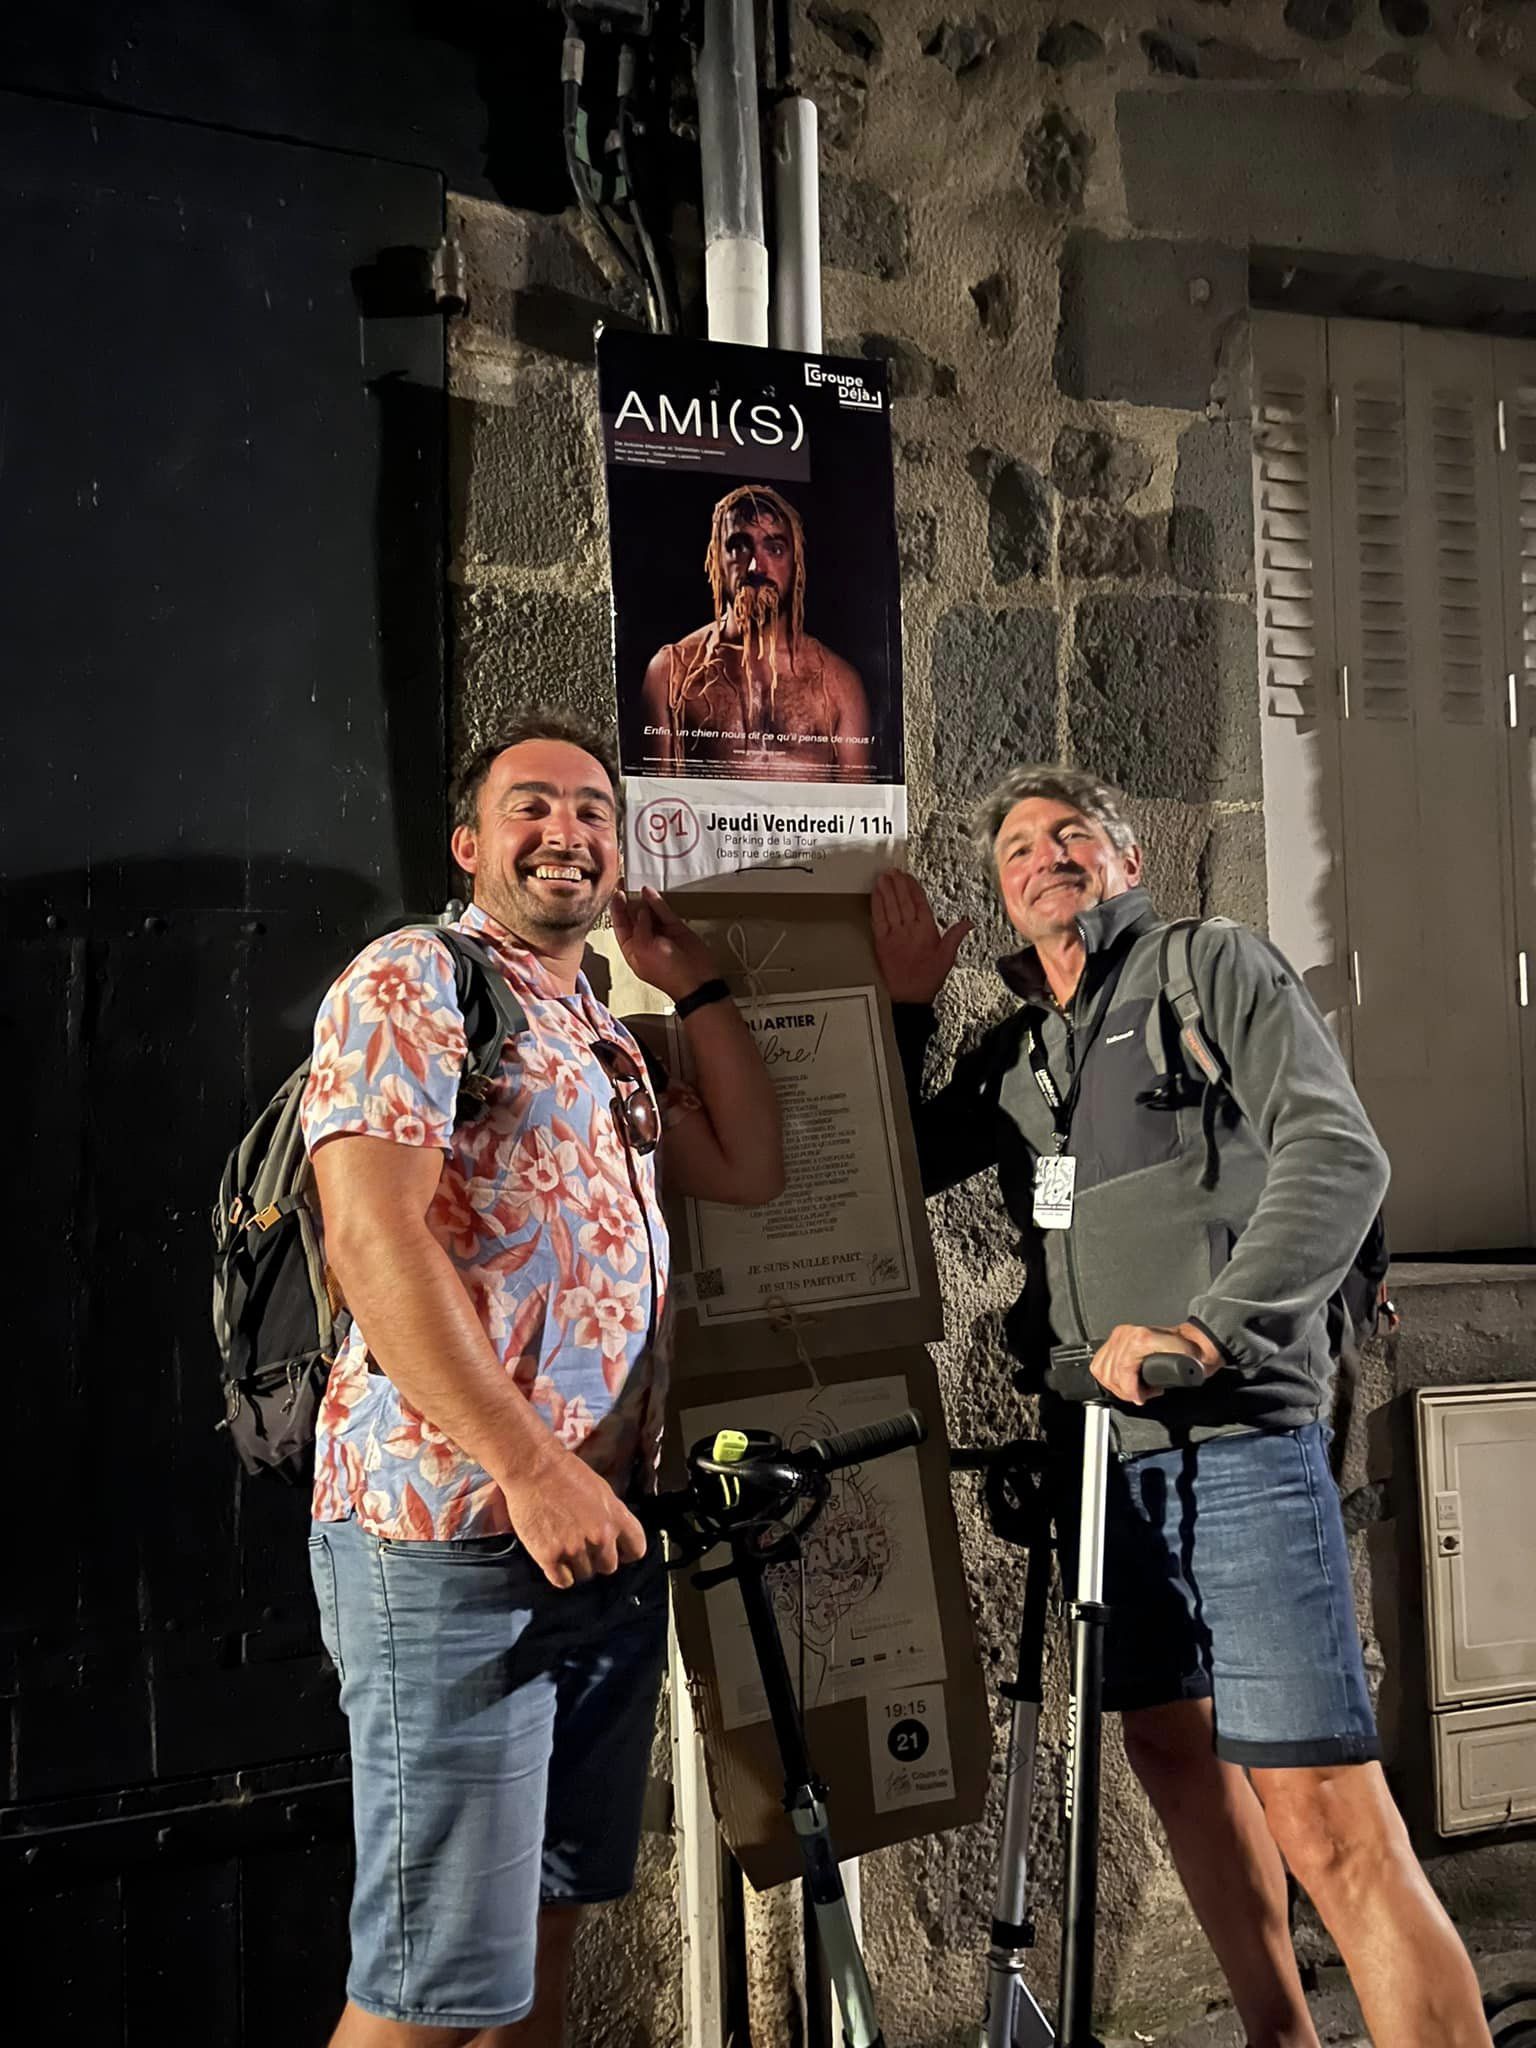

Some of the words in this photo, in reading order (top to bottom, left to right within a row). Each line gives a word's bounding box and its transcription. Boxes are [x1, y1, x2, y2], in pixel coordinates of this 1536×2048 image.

[810, 368, 864, 388] Groupe
[675, 728, 689, 737] un
[691, 728, 719, 738] chien
[721, 731, 746, 740] nous
[748, 730, 760, 740] dit
[762, 732, 775, 741] ce
[776, 733, 797, 743] qu'il
[798, 734, 829, 743] pense
[830, 734, 843, 743] de
[845, 736, 869, 744] nous
[649, 808, 689, 844] 91
[707, 812, 758, 832] Jeudi
[763, 814, 844, 834] Vendredi
[860, 815, 893, 835] 11h
[725, 834, 764, 847] Parking
[767, 834, 780, 846] de
[783, 835, 792, 846] la
[795, 836, 818, 847] Tour
[716, 849, 739, 860] (bas
[742, 851, 760, 859] rue
[762, 849, 781, 860] des
[760, 1010, 828, 1065] bre!
[747, 1264, 762, 1275] JE
[763, 1262, 790, 1273] SUIS
[791, 1255, 830, 1270] NULLE
[757, 1283, 772, 1294] JE
[773, 1280, 801, 1292] SUIS
[802, 1271, 857, 1289] PARTOUT
[896, 1731, 919, 1752] 21
